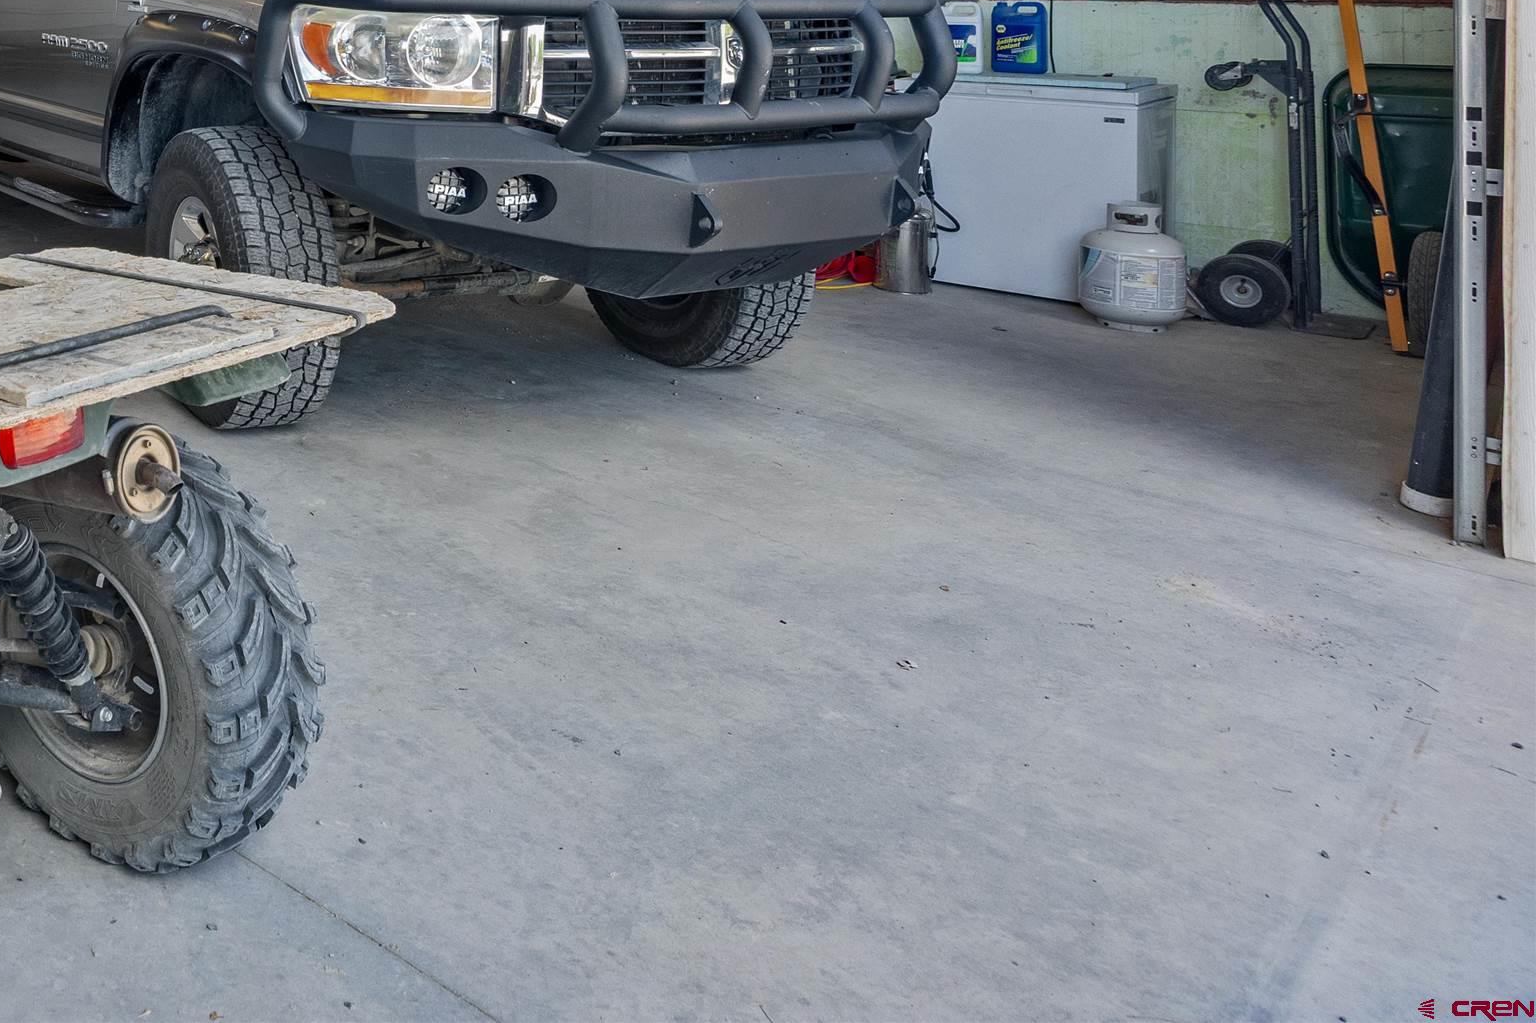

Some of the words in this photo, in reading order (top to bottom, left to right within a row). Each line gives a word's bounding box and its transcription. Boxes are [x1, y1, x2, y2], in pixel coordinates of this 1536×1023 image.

[41, 32, 69, 48] RAM
[70, 37, 108, 54] 2500
[434, 184, 466, 198] PIAA
[504, 193, 538, 206] PIAA
